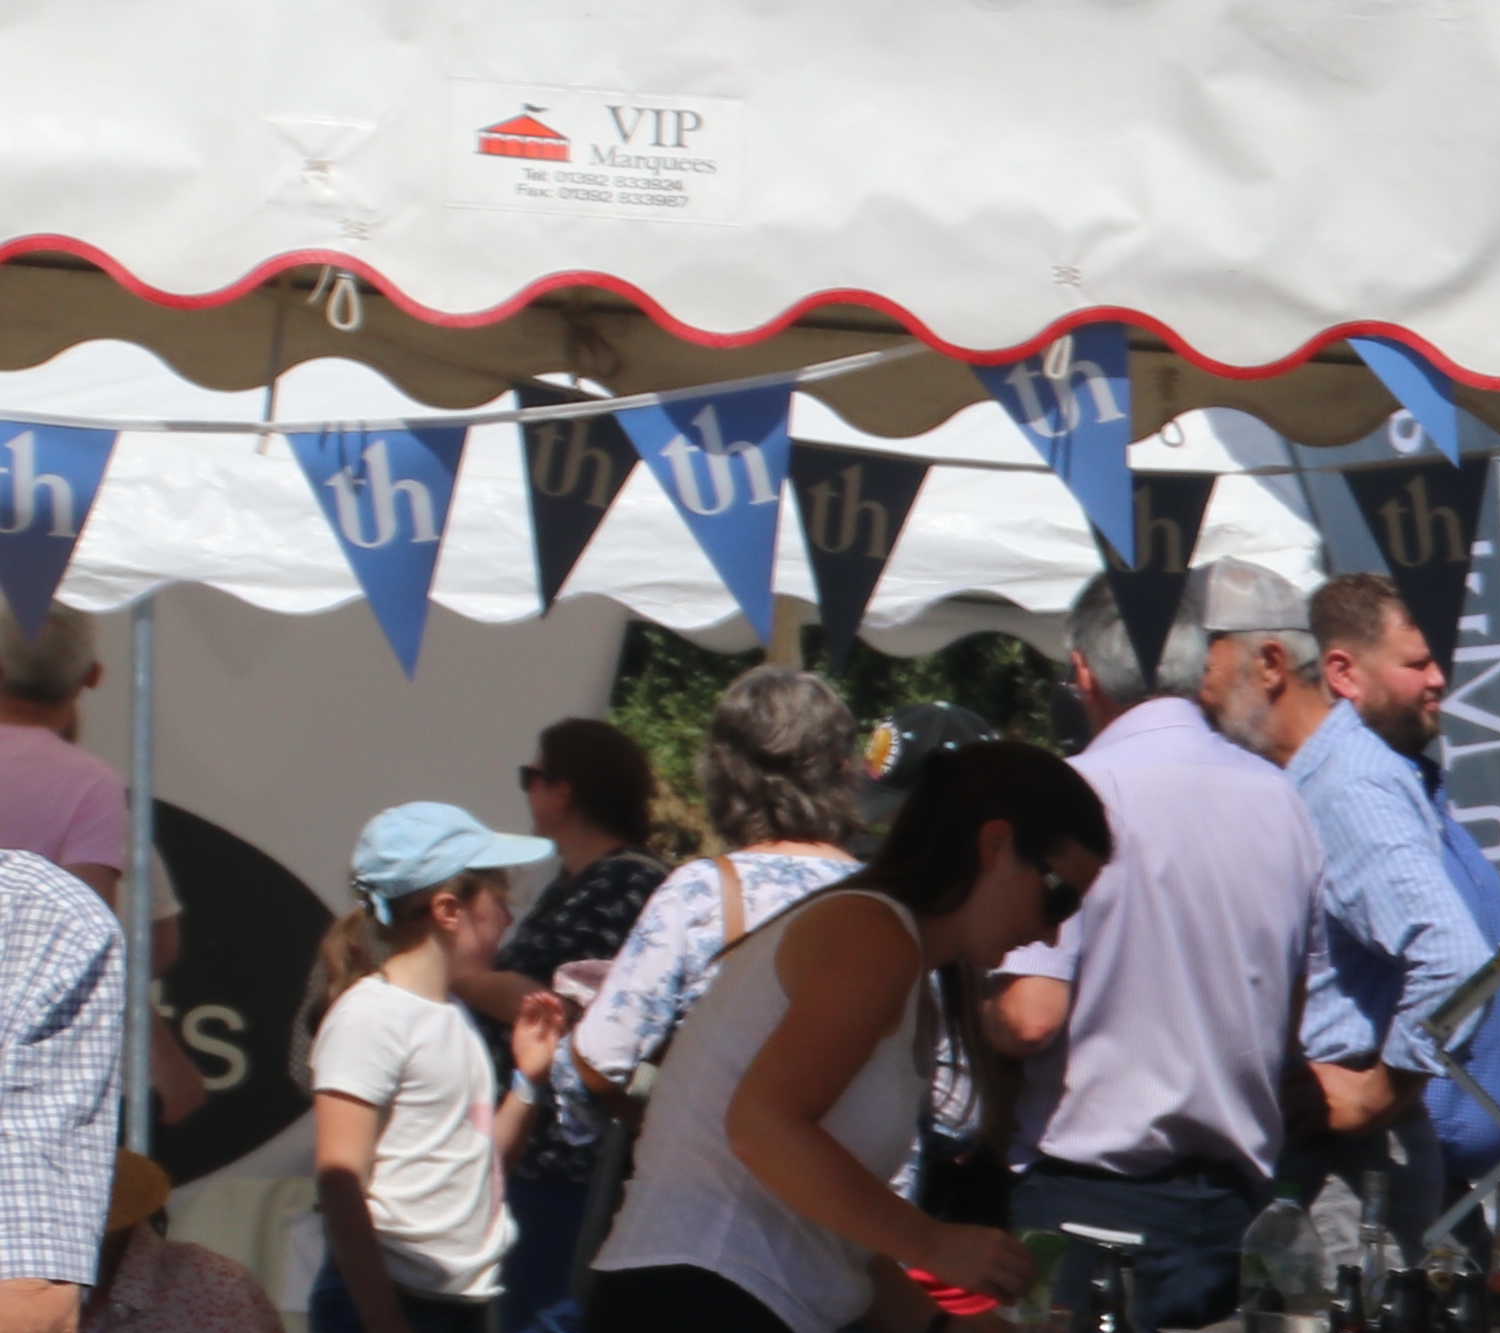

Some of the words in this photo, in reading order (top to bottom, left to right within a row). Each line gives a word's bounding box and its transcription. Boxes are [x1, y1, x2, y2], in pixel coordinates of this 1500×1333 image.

[606, 105, 703, 148] VIP
[587, 143, 718, 176] Marquees
[555, 170, 609, 187] 01392
[515, 183, 552, 199] Fax:
[558, 187, 613, 204] 01392
